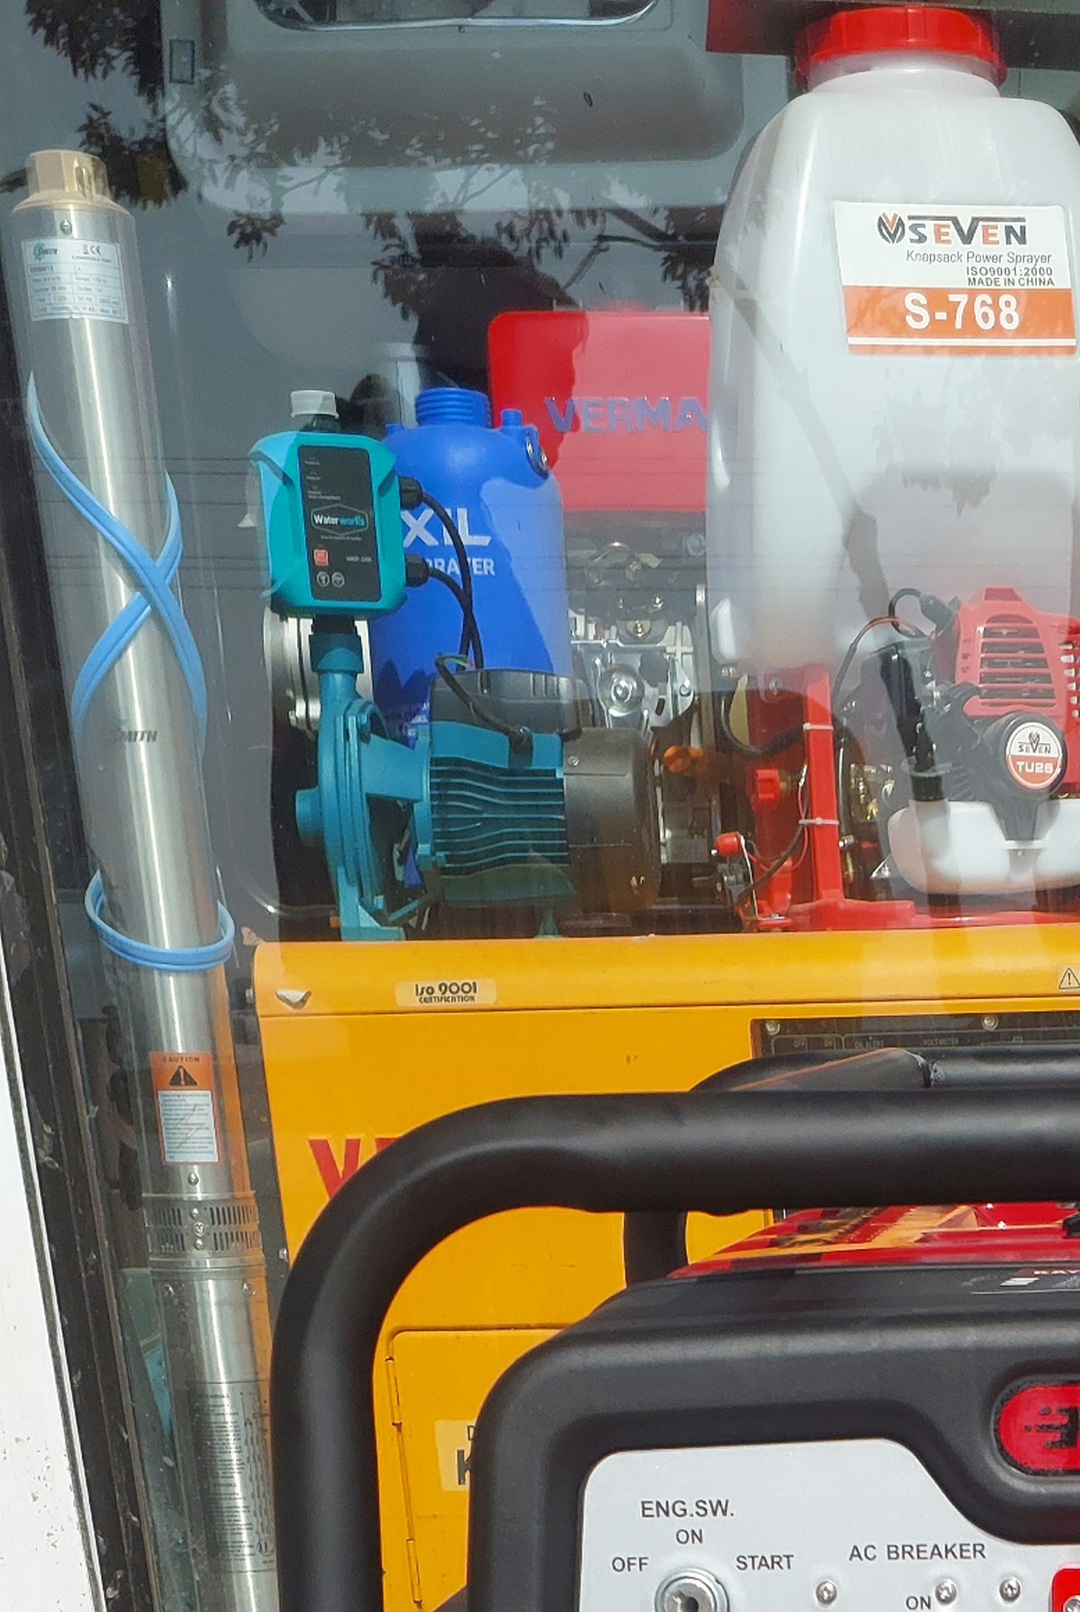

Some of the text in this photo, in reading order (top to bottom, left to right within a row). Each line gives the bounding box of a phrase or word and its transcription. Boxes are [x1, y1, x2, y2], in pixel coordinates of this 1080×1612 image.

[907, 214, 1028, 246] SEVEN
[905, 249, 1053, 267] Knapsack Power Sprayer
[966, 266, 1053, 278] ISO9001:2000
[967, 277, 1055, 287] MADE IN CHINA
[904, 292, 1021, 331] S-768
[1018, 740, 1052, 754] SEVEN
[418, 995, 476, 1004] CERTIFICATION
[640, 1499, 735, 1519] ENG.SW.
[675, 1528, 704, 1545] ON
[848, 1543, 987, 1562] AC BREAKER
[611, 1556, 650, 1573] OFF
[735, 1554, 795, 1571] START
[905, 1595, 932, 1611] ON
